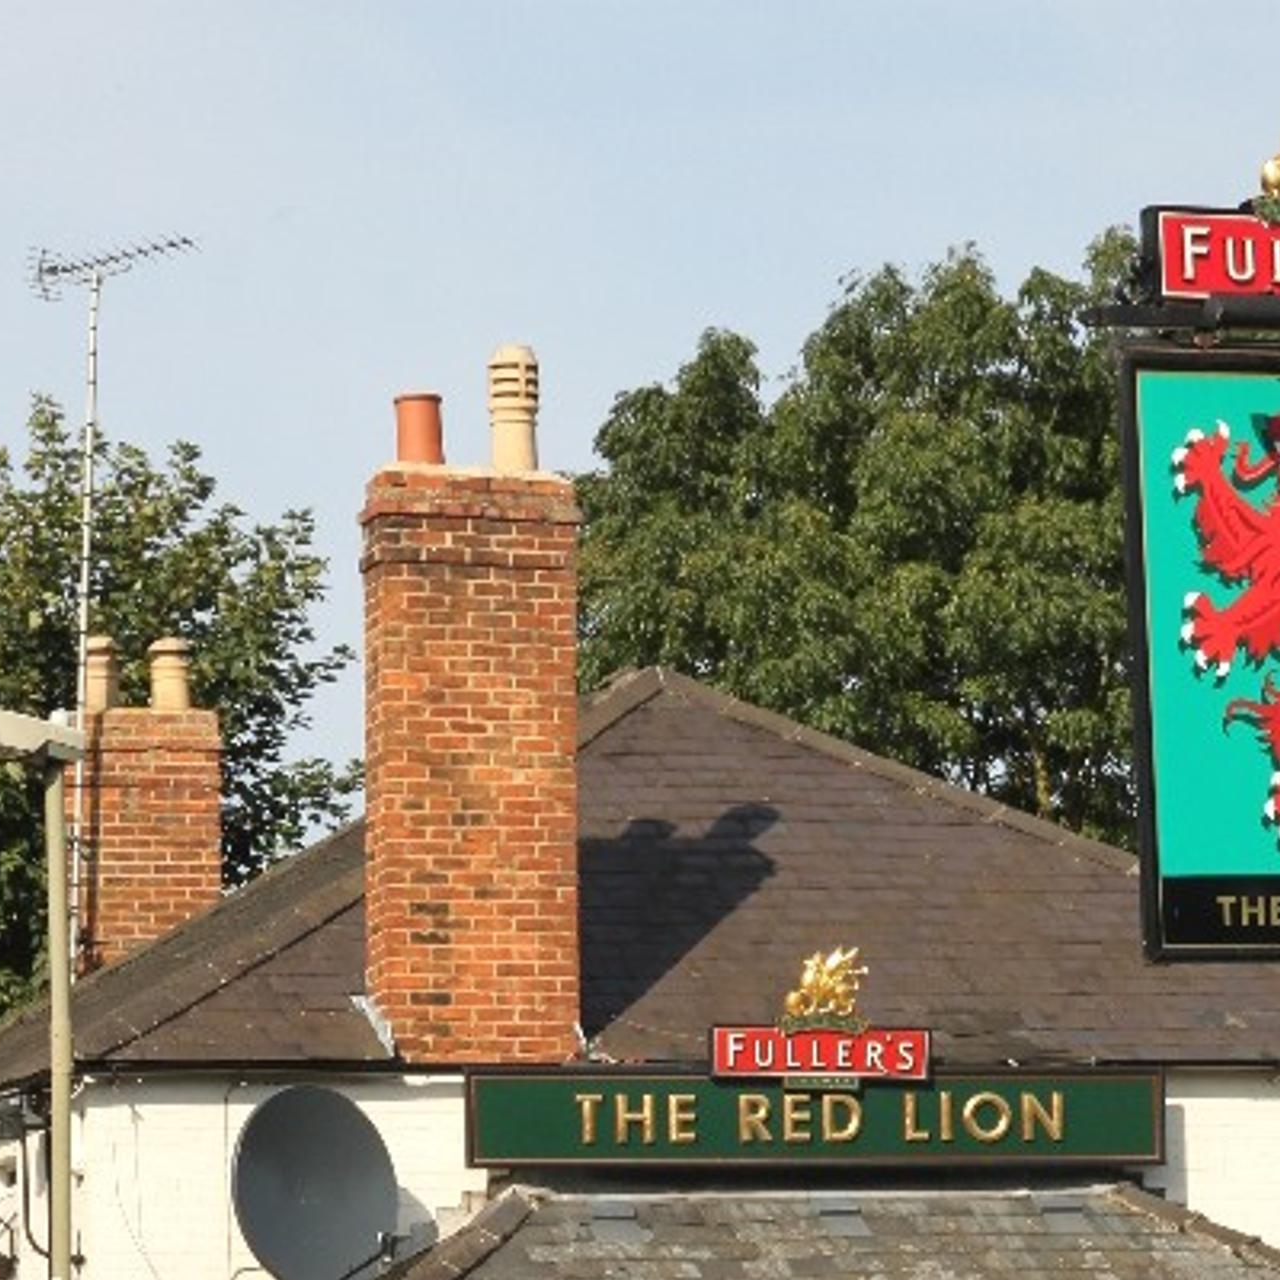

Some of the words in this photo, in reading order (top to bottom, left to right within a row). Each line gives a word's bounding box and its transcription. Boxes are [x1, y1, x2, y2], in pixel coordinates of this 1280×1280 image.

[727, 1032, 915, 1074] FULLER'S
[575, 1093, 696, 1145] THE
[738, 1093, 863, 1143] RED
[904, 1090, 1065, 1143] LION
